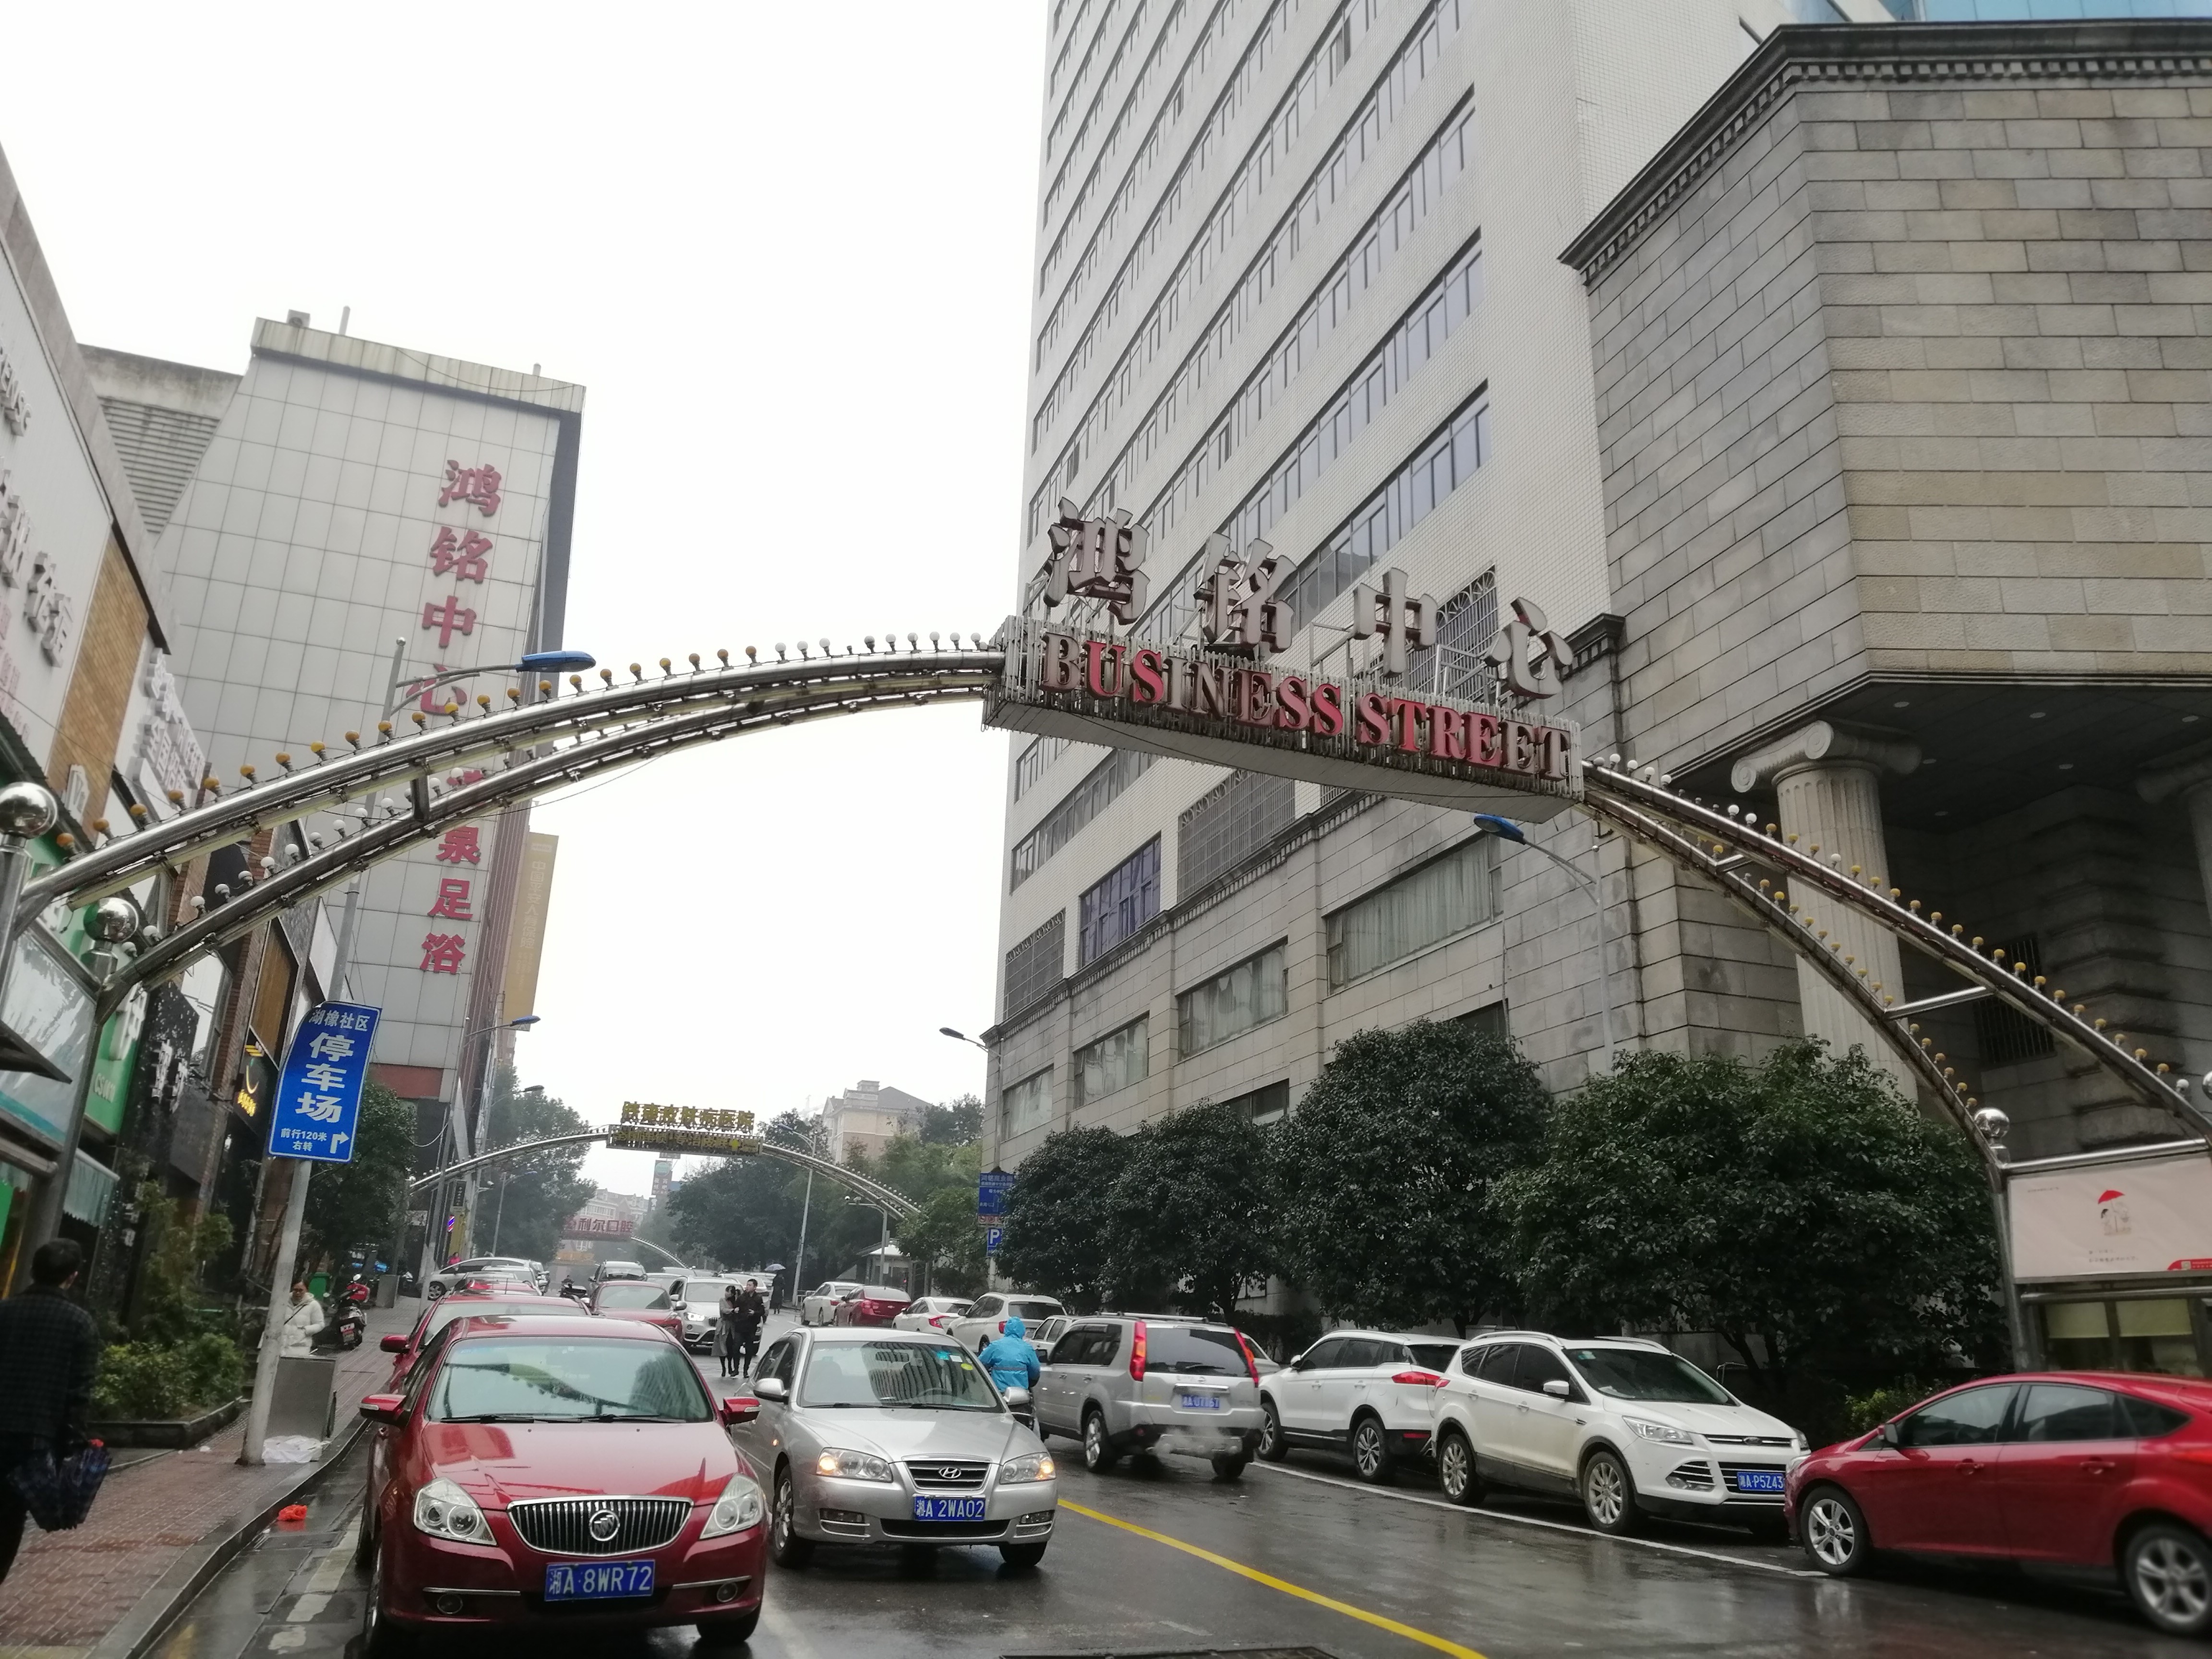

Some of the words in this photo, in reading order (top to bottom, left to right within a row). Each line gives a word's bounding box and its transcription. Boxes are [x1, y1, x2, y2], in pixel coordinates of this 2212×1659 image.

[406, 459, 502, 715] 鸿铭中心
[1043, 497, 1574, 699] 鸿铭中心
[1040, 631, 1343, 737] BUSINESS
[1355, 692, 1571, 781] STREET
[309, 1009, 371, 1032] 湖橡社区
[295, 1032, 356, 1123] 停车场
[280, 1128, 327, 1142] 前行120米
[292, 1141, 313, 1152] 右转
[990, 1228, 1000, 1244] P
